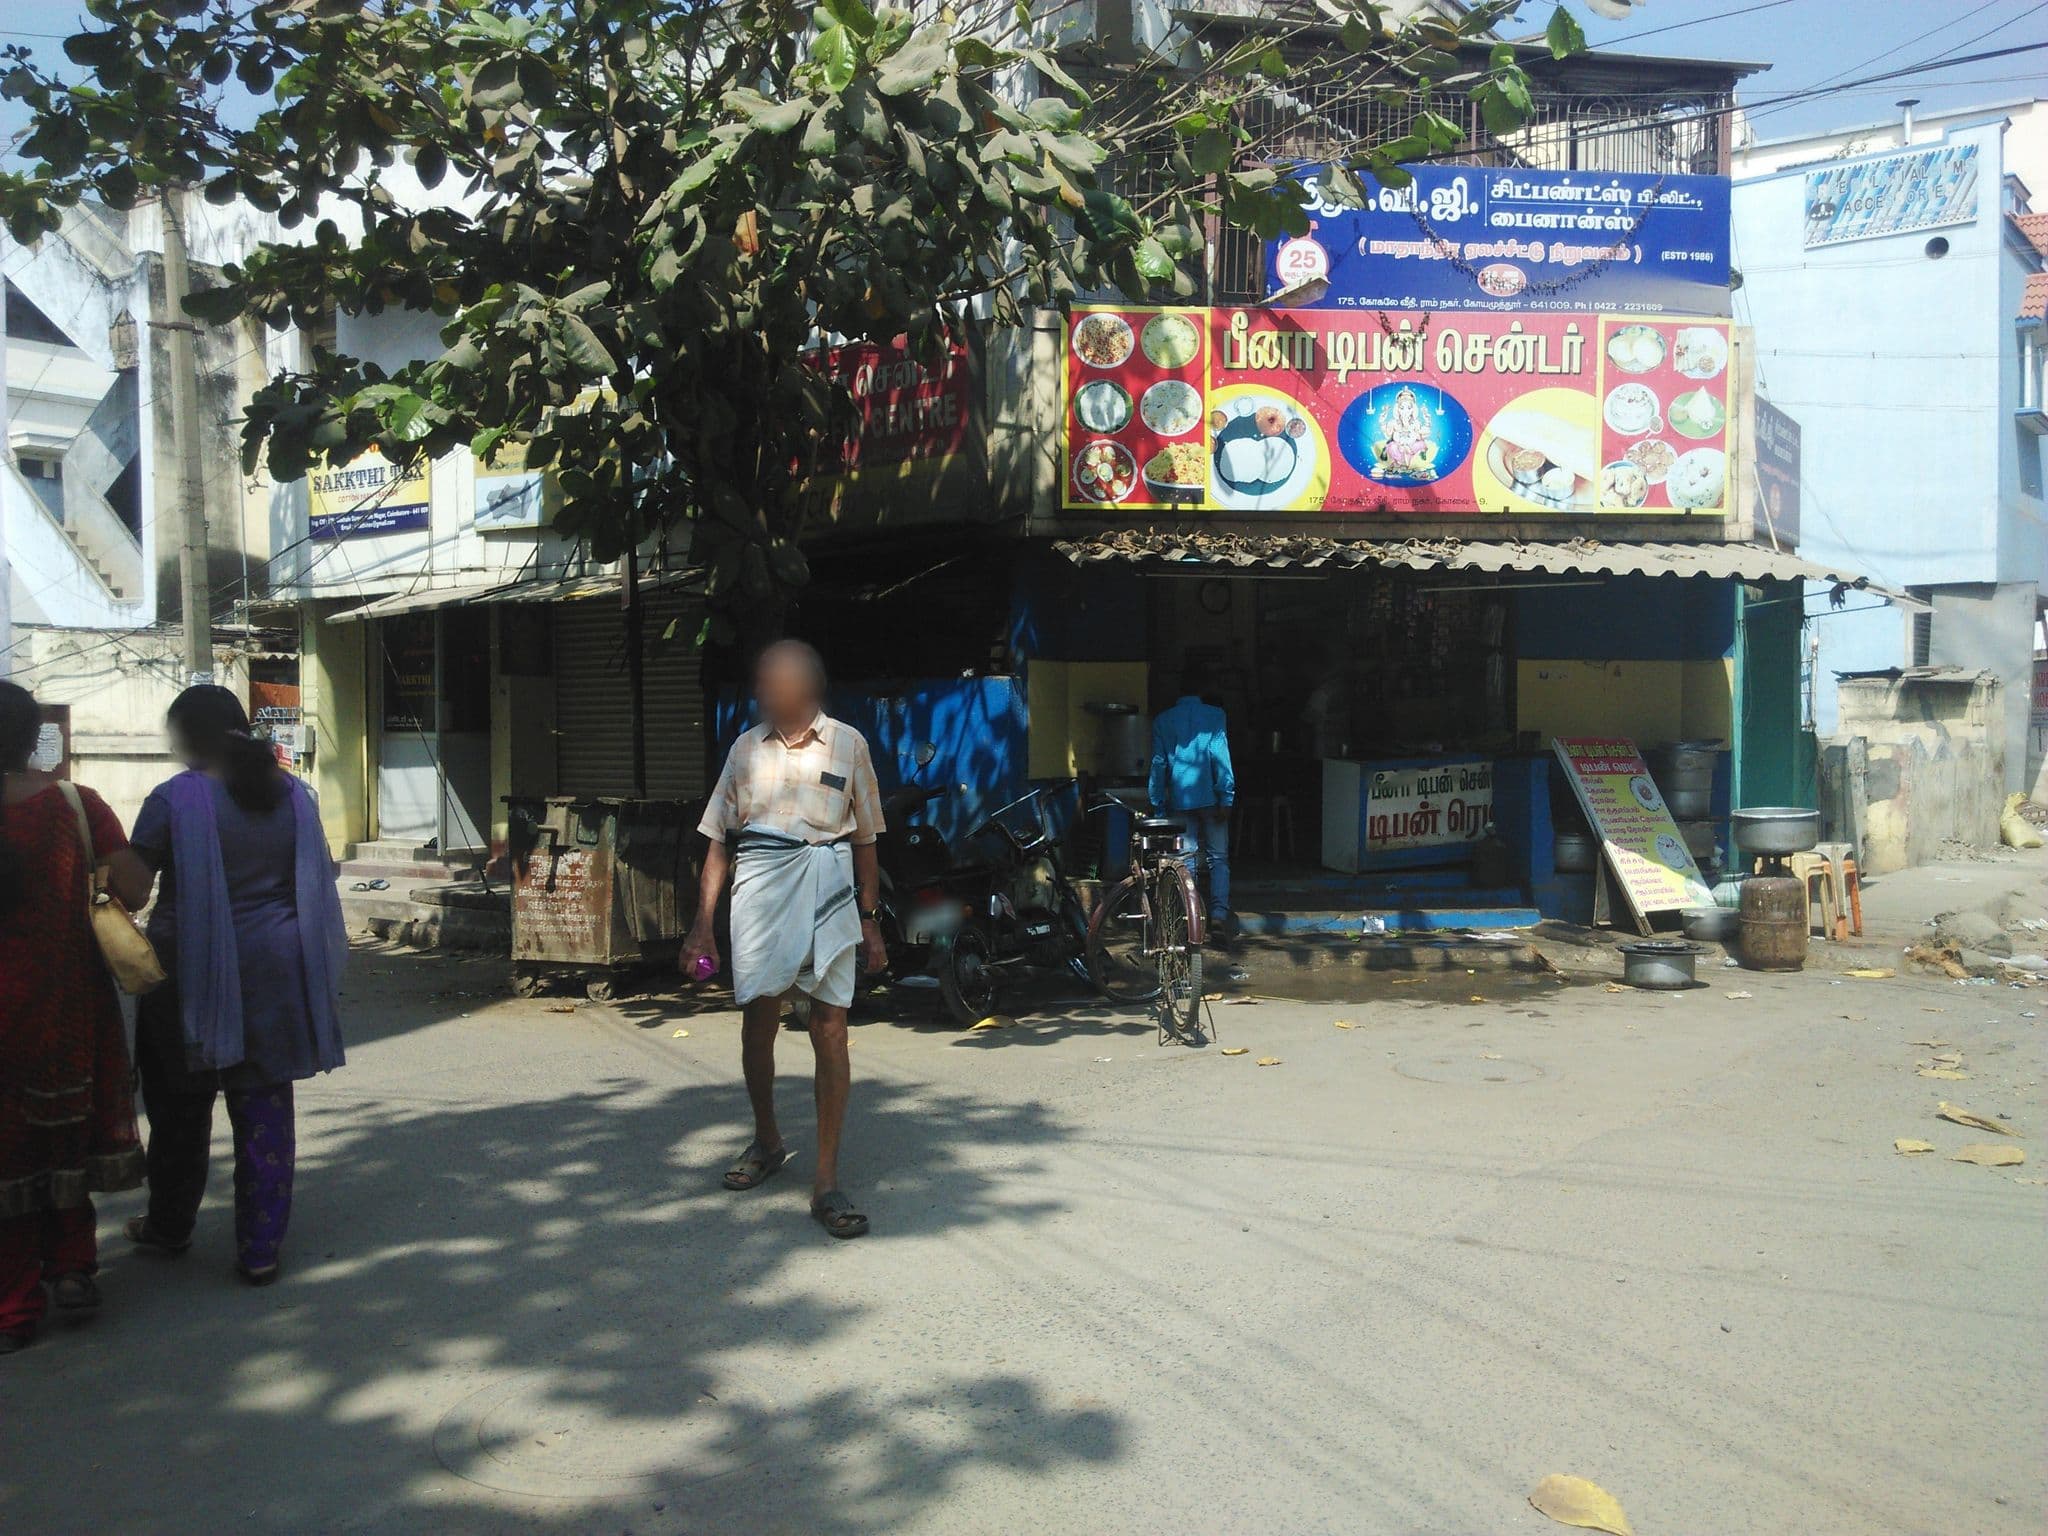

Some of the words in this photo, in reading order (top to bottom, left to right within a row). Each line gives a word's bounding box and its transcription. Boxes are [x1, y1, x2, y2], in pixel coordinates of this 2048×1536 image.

[1289, 250, 1317, 269] 25
[1223, 312, 1317, 371] பீனா
[1327, 318, 1427, 383] டிபன்
[1436, 320, 1586, 374] சென்டர்
[313, 466, 386, 494] SAKKTHI
[390, 461, 425, 482] TX
[1417, 767, 1453, 799] டிபன்
[1368, 801, 1442, 845] டிபன்
